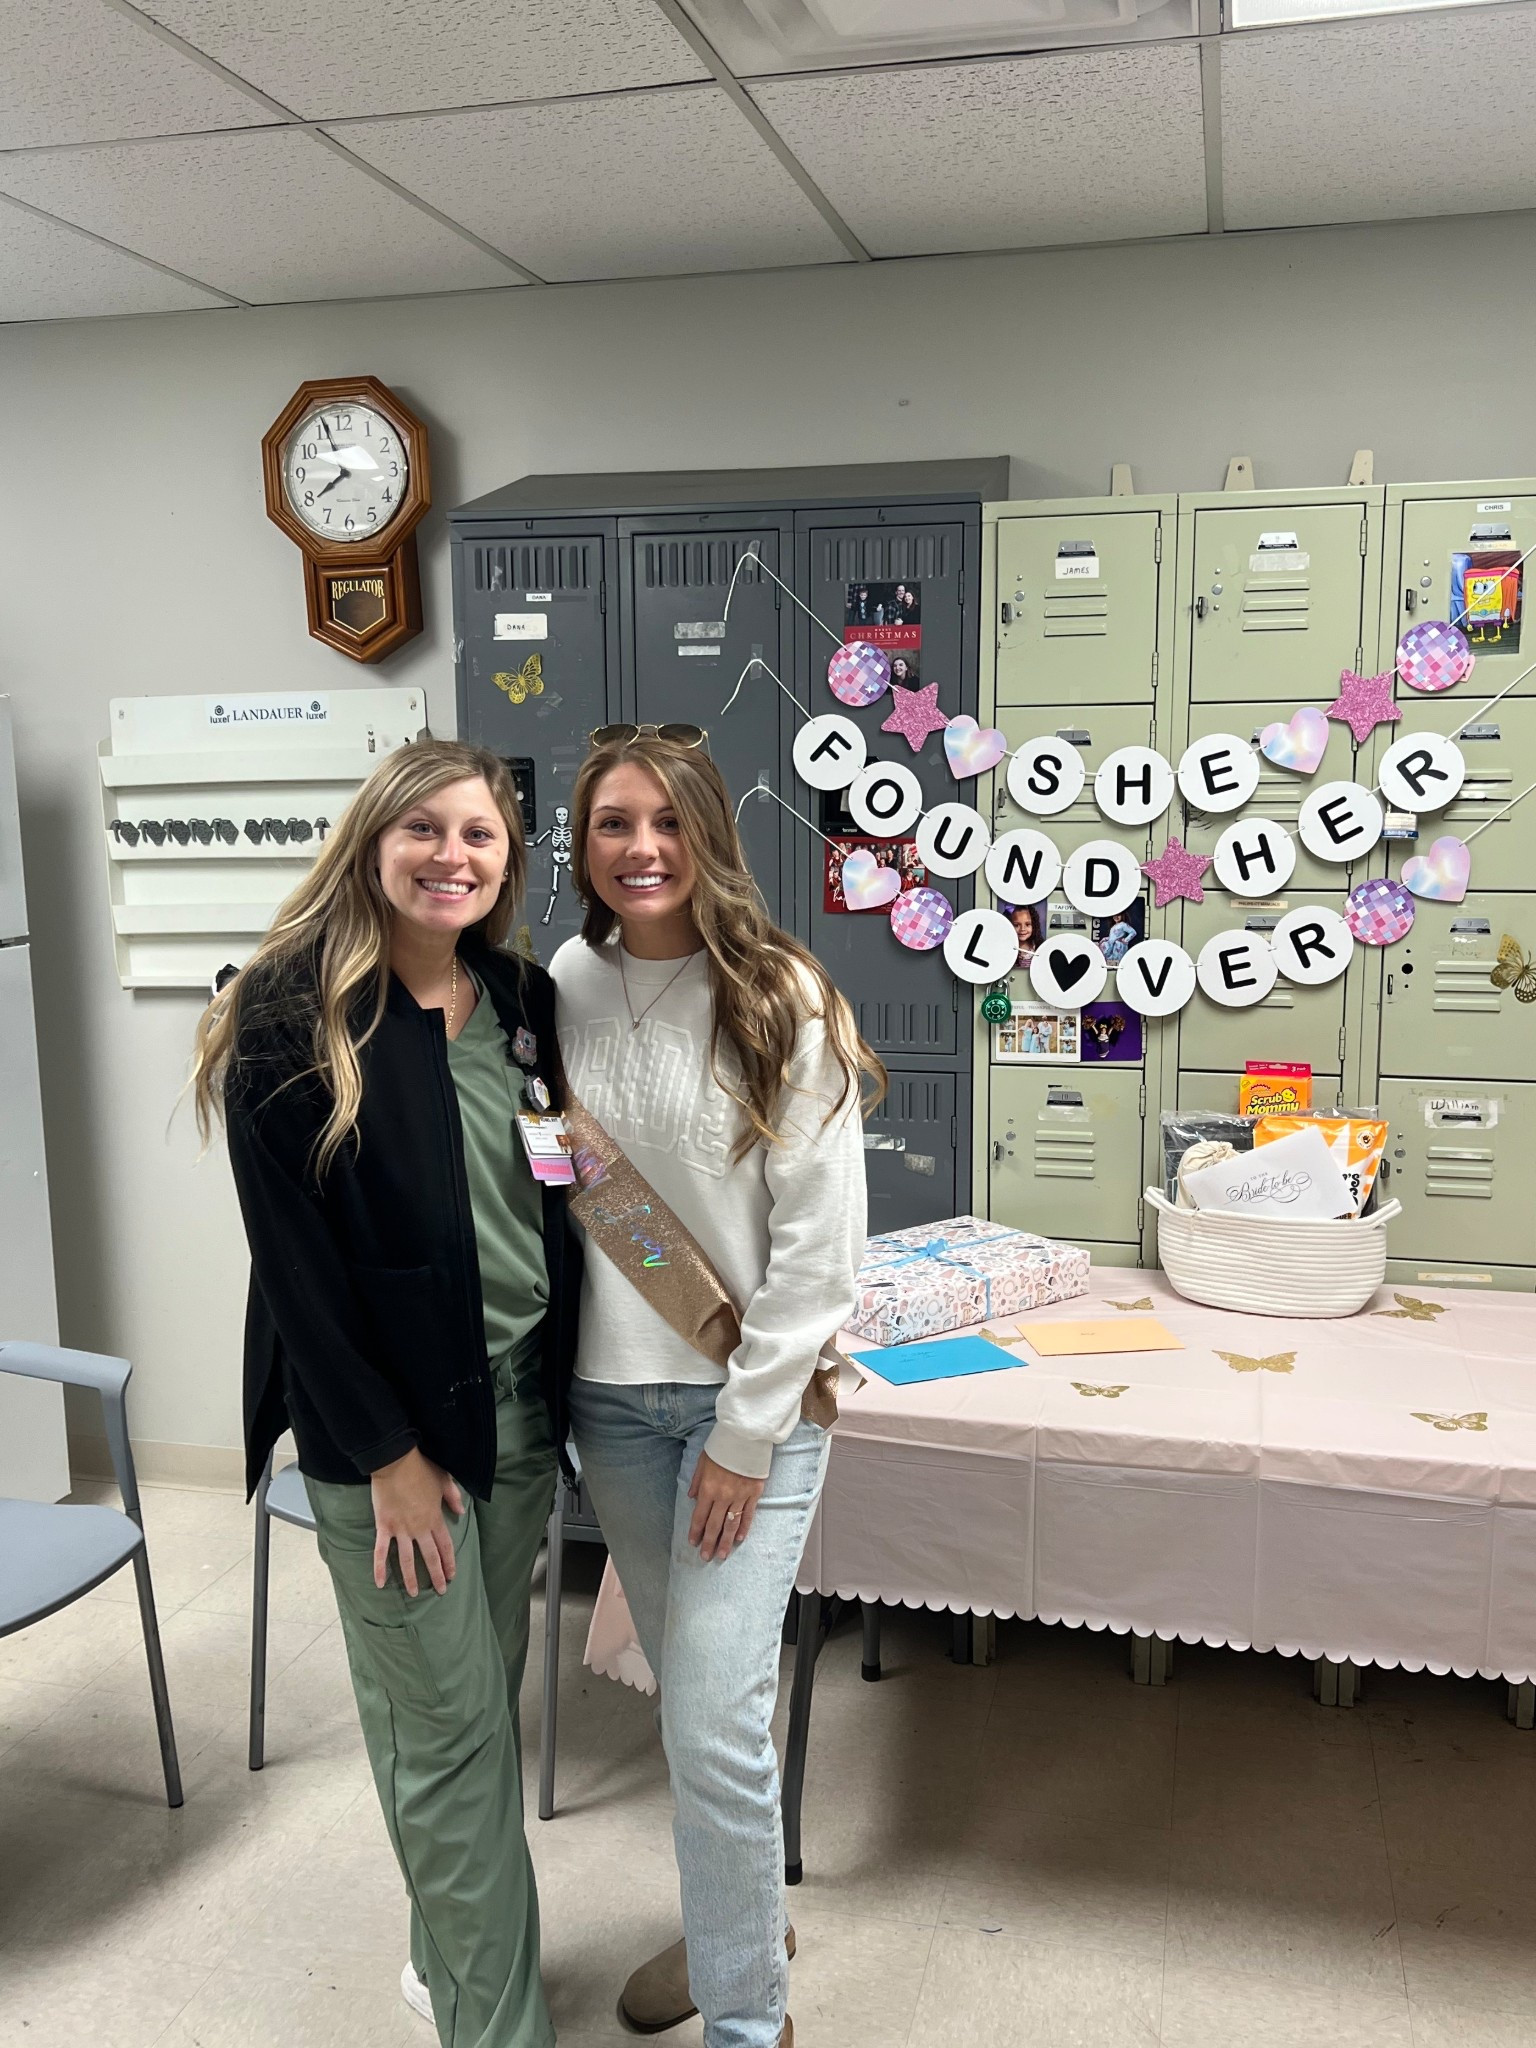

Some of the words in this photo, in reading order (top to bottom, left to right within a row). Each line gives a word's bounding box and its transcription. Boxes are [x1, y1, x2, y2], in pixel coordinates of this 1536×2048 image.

[335, 414, 352, 431] 12
[364, 421, 371, 437] 1
[301, 442, 318, 460] 10
[380, 437, 390, 453] 2
[295, 467, 306, 485] 9
[389, 461, 399, 477] 3
[303, 490, 315, 507] 8
[381, 486, 393, 503] 4
[322, 507, 332, 524] 7
[344, 513, 355, 531] 6
[366, 506, 377, 522] 5
[1062, 566, 1090, 576] JAMES
[331, 579, 385, 600] REGULATOR
[849, 631, 917, 640] CHRISTMAS
[232, 707, 303, 721] LANDAUER
[1027, 749, 1240, 806] SHE
[809, 730, 1120, 898] FOUND
[1231, 749, 1449, 882] HER
[1250, 1093, 1283, 1106] Scrub
[1246, 1102, 1300, 1116] Mommy
